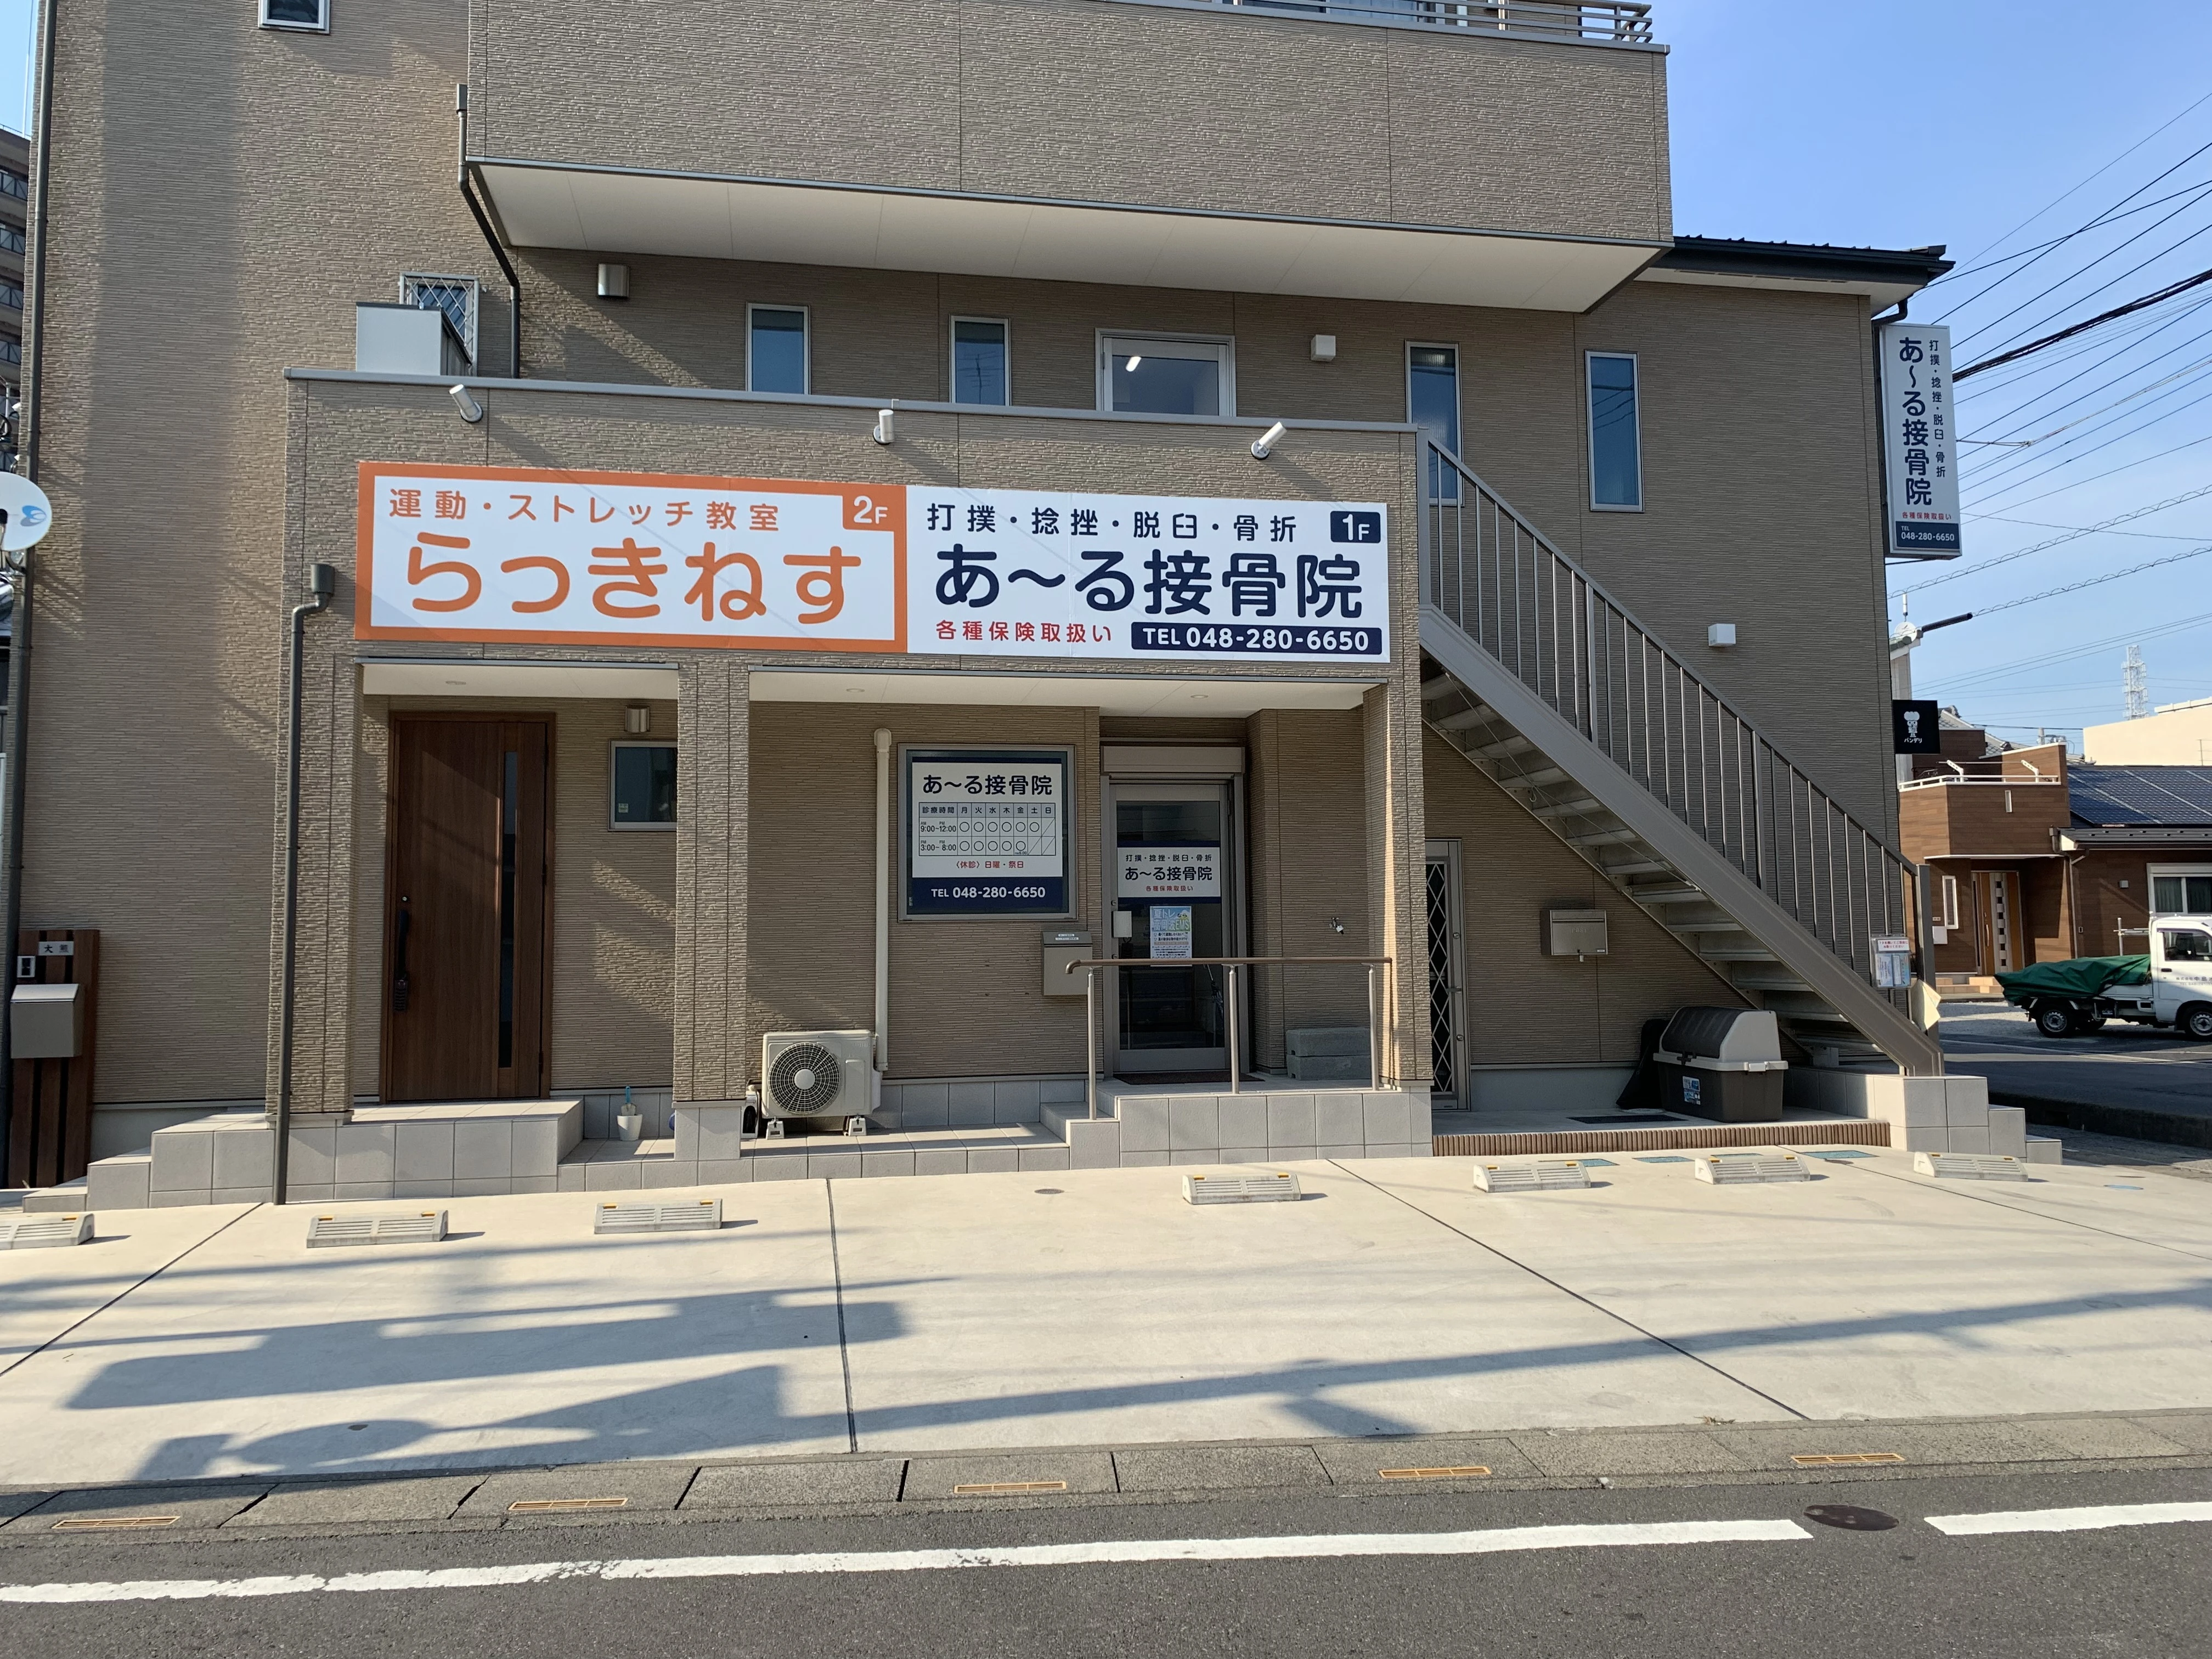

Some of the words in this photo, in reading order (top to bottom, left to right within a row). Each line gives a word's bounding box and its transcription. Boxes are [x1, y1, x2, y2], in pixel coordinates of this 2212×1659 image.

[389, 489, 778, 532] 運動・ストレッチ教室
[854, 496, 888, 523] 2F
[1901, 511, 1952, 520] 各種保険取扱い
[927, 503, 1297, 543] 打撲・捻挫・脱臼・骨折
[1342, 514, 1370, 540] 1F
[1901, 532, 1955, 541] 048-280-6650
[407, 532, 861, 624] らっきねす
[936, 620, 1110, 642] 各種保険取扱い
[1143, 628, 1180, 645] TEL
[1186, 627, 1369, 650] 048-280-6650
[931, 889, 949, 897] TEL
[953, 887, 1045, 898] 048-280-6650
